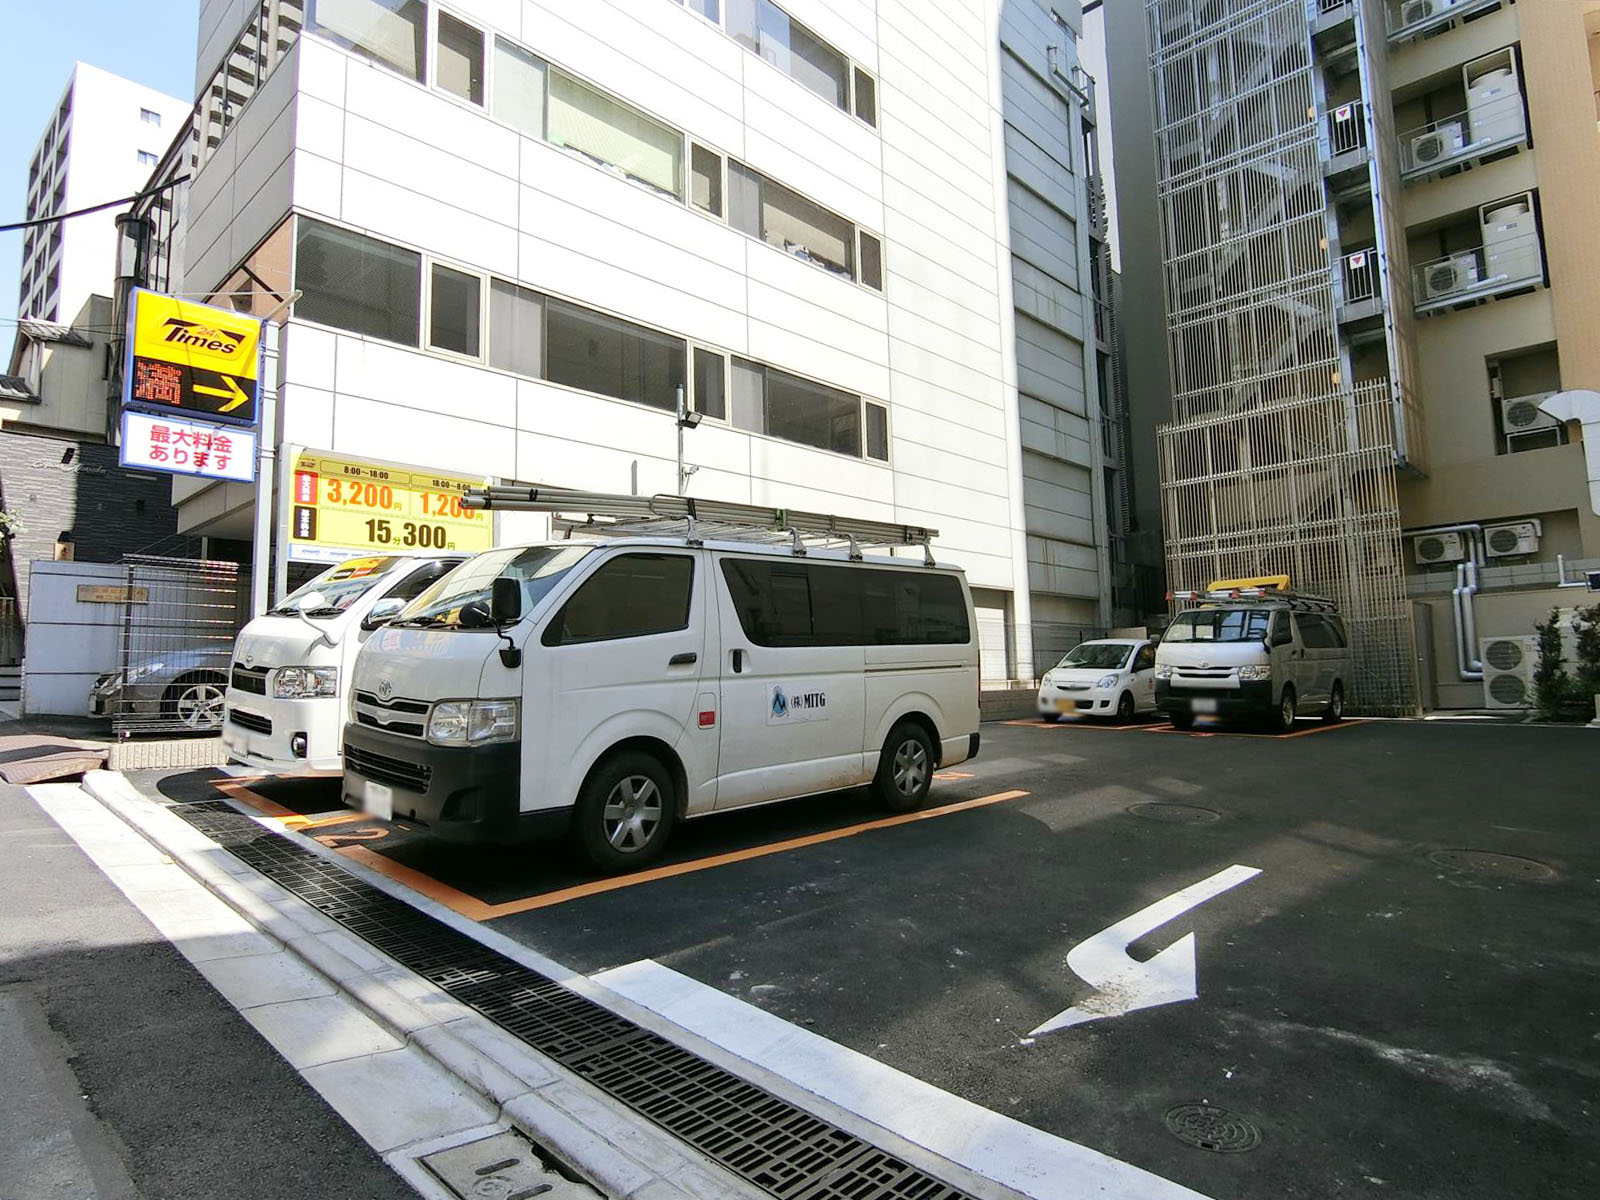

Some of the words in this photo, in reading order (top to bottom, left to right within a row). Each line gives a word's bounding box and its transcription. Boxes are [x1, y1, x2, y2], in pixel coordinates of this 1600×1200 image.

[162, 318, 237, 354] Times
[150, 425, 232, 454] 最大料金
[149, 445, 232, 470] あります
